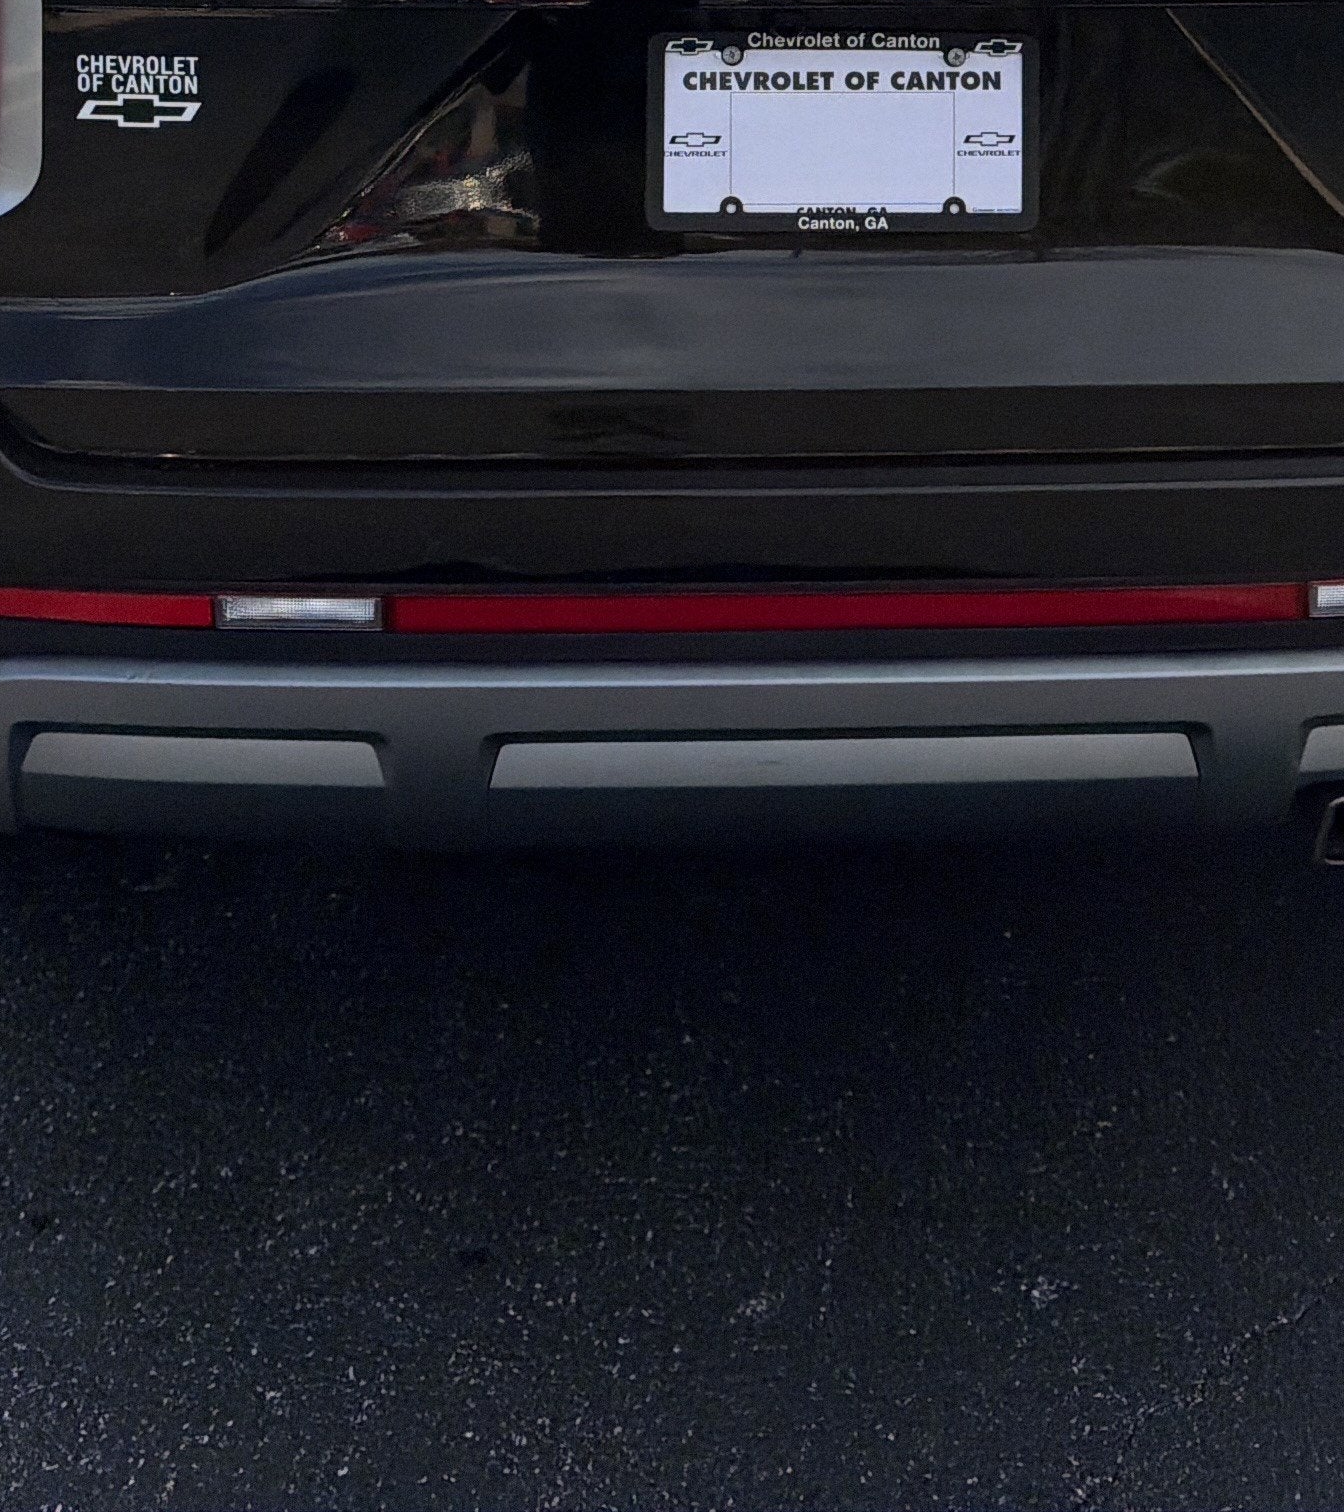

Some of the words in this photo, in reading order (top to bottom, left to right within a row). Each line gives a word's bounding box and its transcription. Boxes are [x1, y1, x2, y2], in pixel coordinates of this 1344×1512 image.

[747, 32, 840, 48] Chevrolet
[846, 32, 865, 48] of
[872, 32, 940, 49] Canton
[76, 54, 199, 76] CHEVROLET
[77, 73, 104, 93] OF
[111, 74, 198, 95] CANTON
[682, 71, 835, 91] CHEVROLET
[844, 71, 880, 90] OF
[890, 71, 1002, 91] CANTON
[664, 150, 728, 158] CHEVROLET
[957, 149, 1020, 157] CHEVROLET
[798, 215, 860, 232] Canton,
[864, 216, 889, 230] GA
